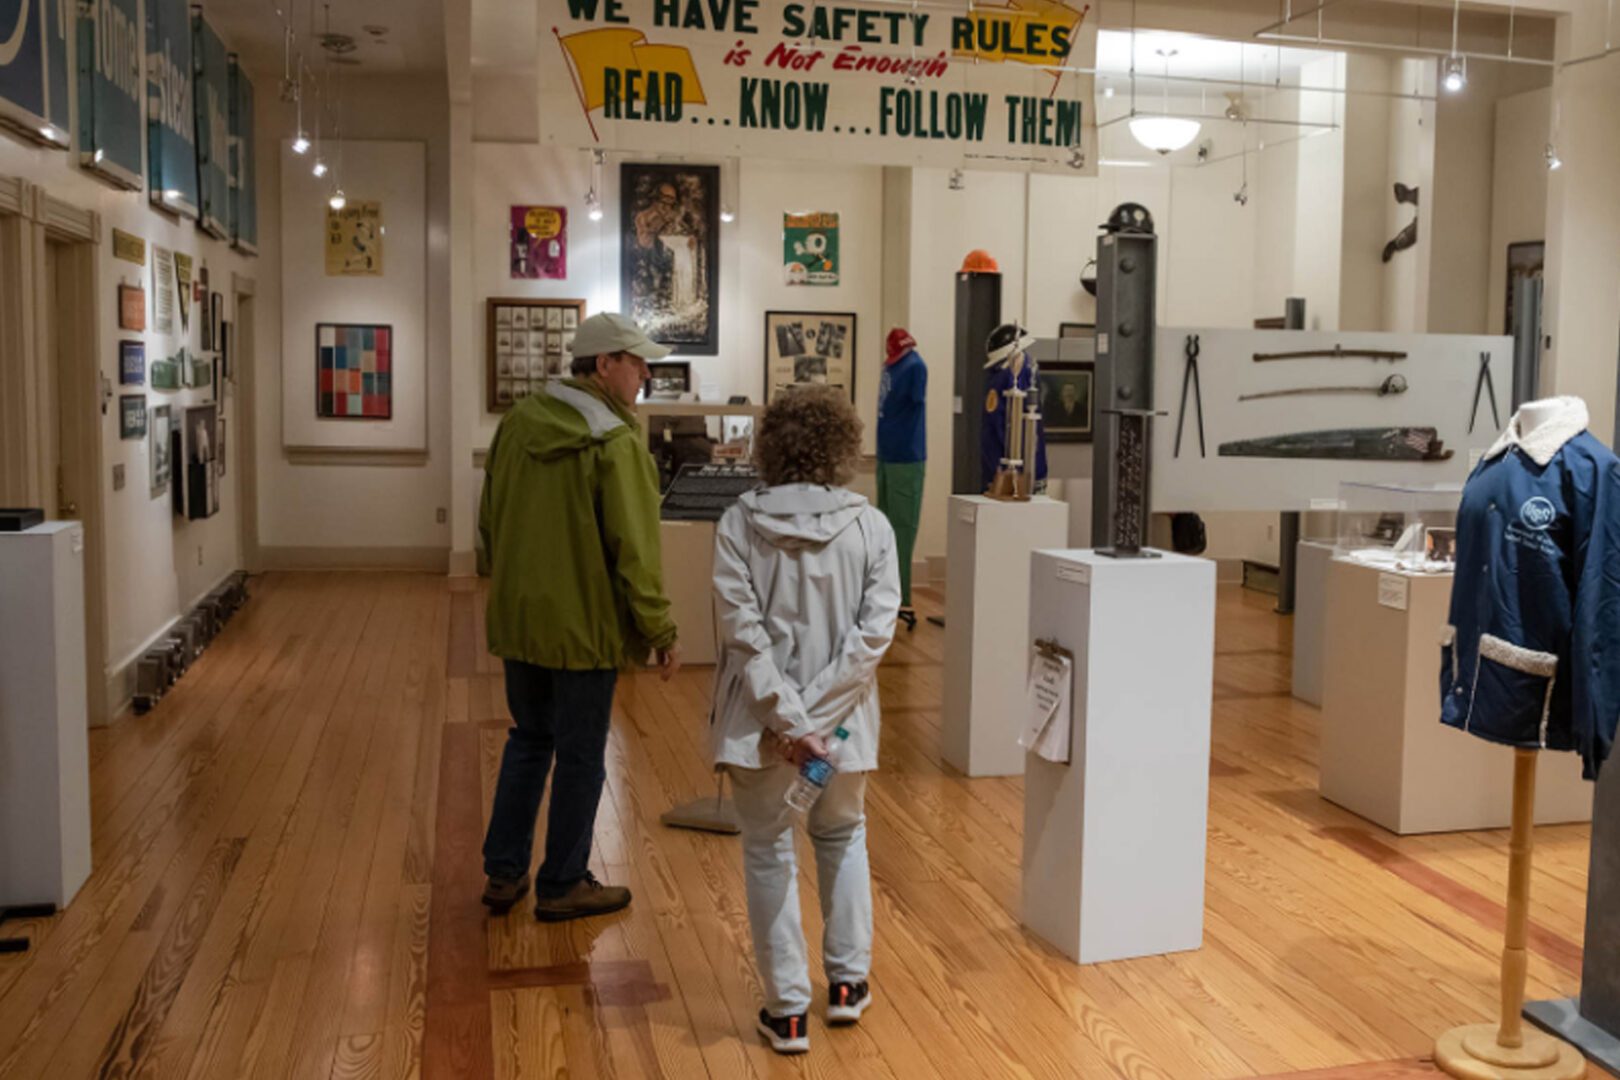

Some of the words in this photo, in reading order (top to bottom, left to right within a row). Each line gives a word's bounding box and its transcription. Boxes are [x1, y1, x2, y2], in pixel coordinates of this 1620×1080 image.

[567, 0, 630, 24] WE
[653, 0, 758, 34] HAVE
[782, 4, 930, 47] SAFETY
[952, 16, 1071, 57] RULES
[723, 40, 751, 66] is
[764, 42, 824, 72] Not
[833, 45, 948, 78] Enough
[879, 86, 988, 142] FOLLOW
